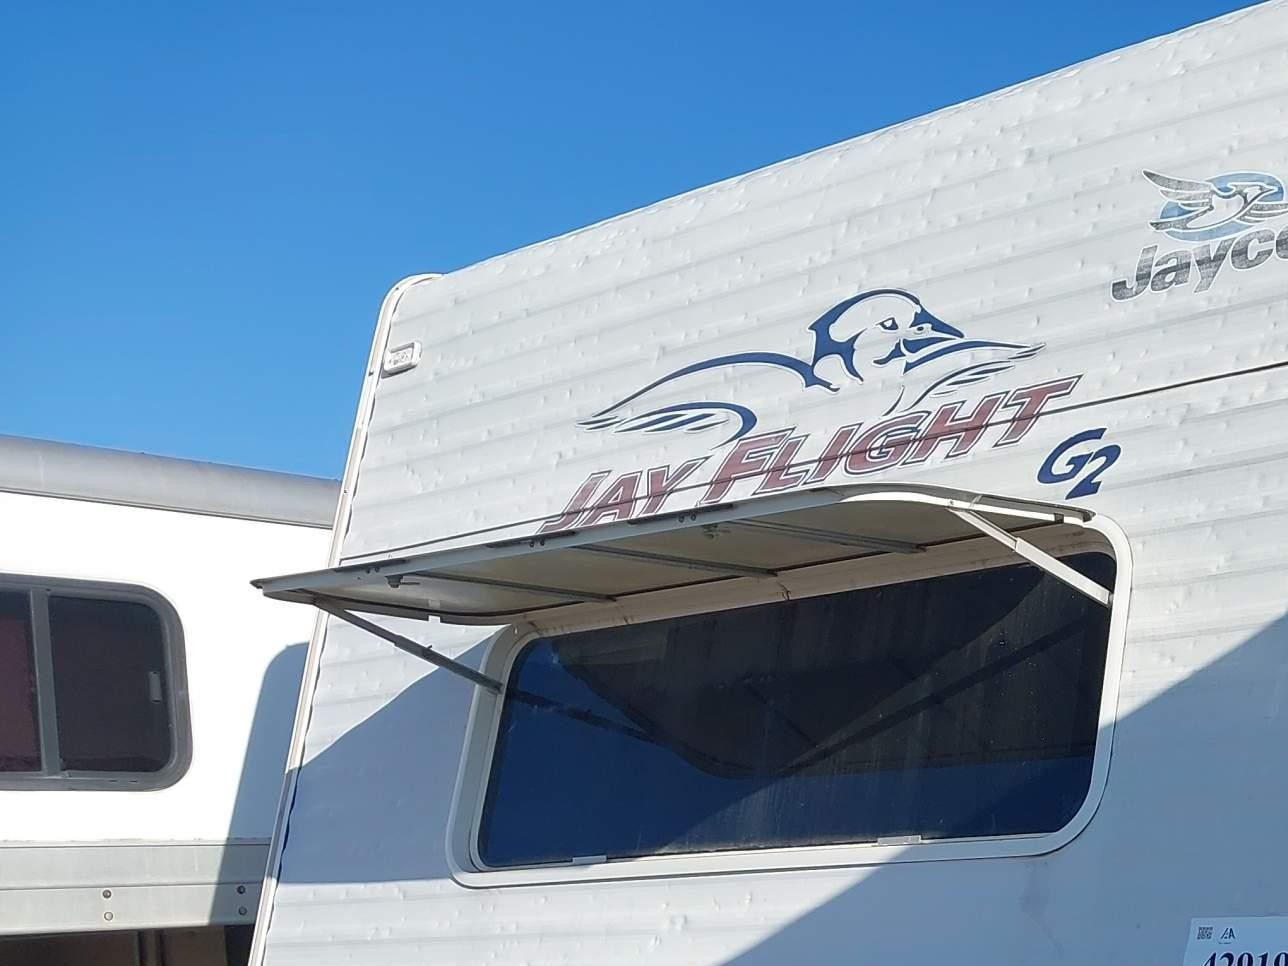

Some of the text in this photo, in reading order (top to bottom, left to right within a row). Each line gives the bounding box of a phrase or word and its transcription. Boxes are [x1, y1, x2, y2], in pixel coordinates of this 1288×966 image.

[537, 373, 1086, 535] JAY FLIGHT
[1036, 427, 1122, 501] G2
